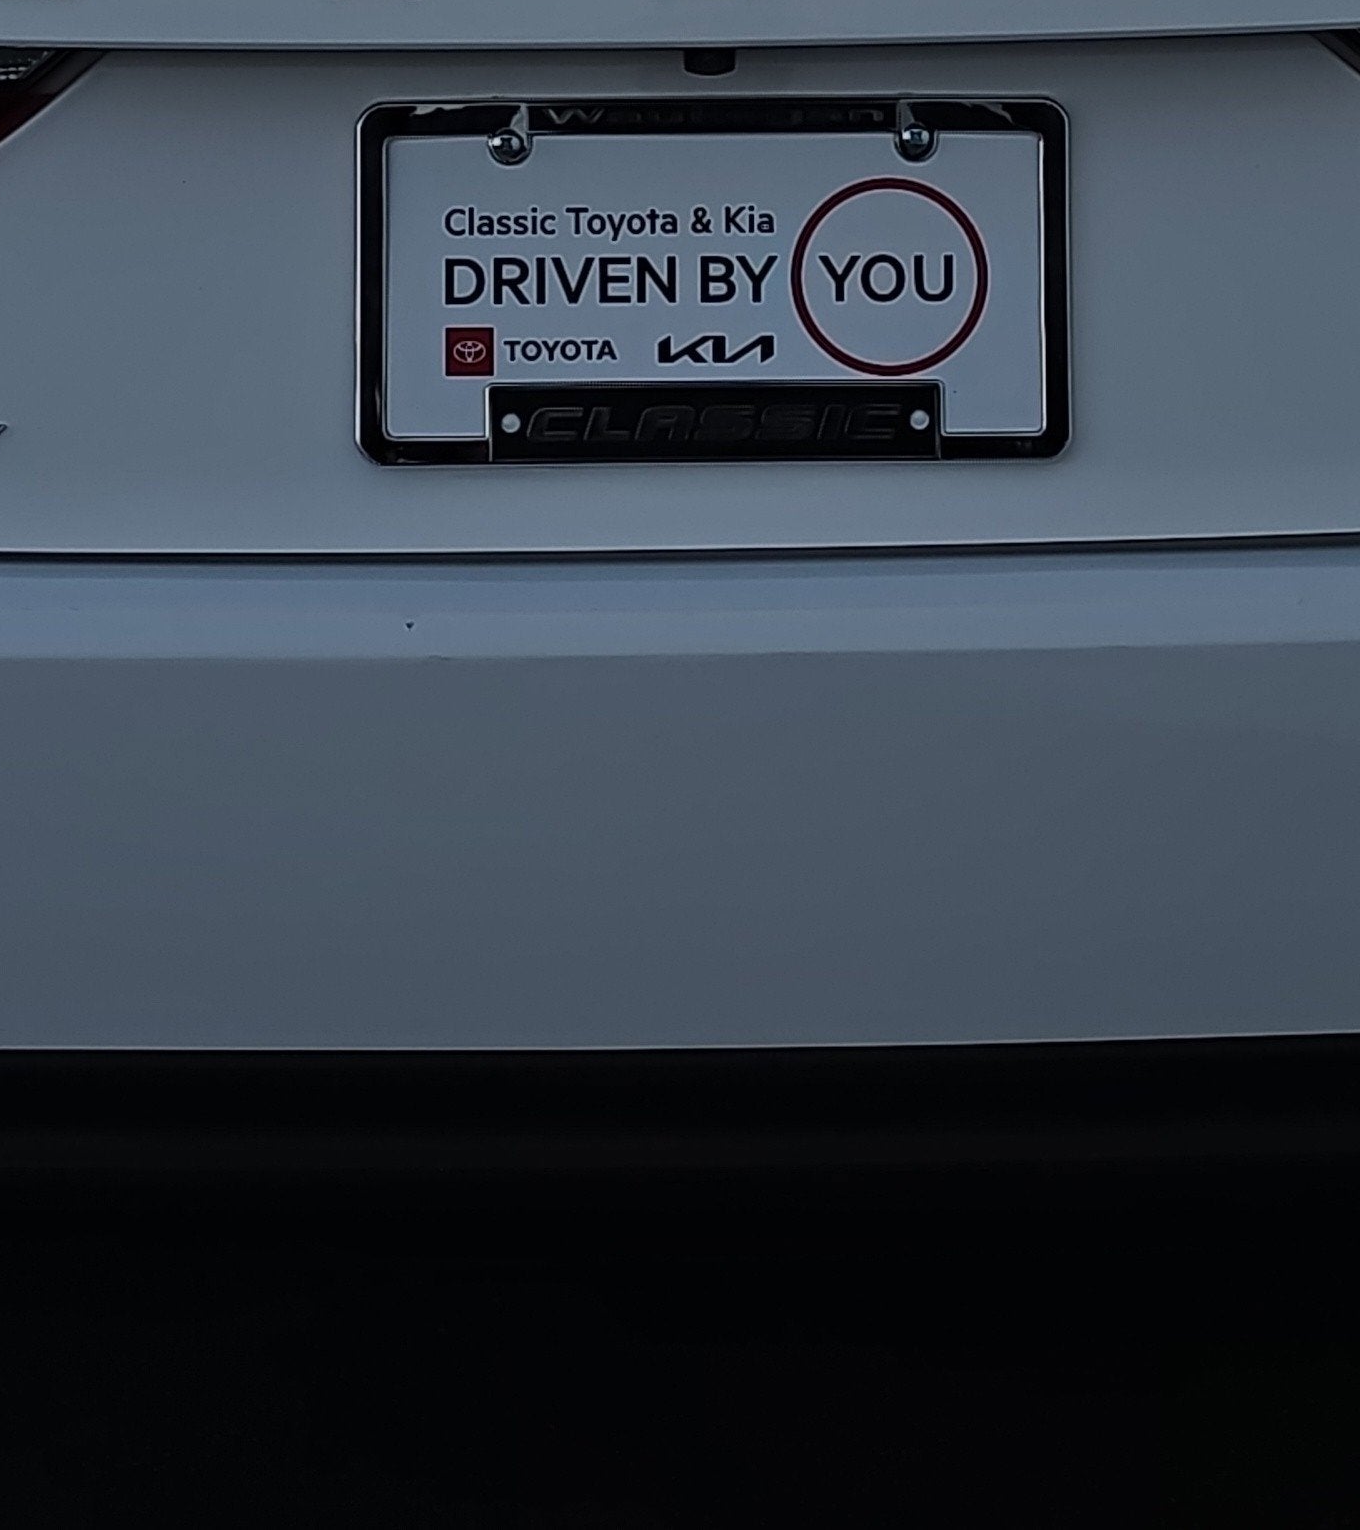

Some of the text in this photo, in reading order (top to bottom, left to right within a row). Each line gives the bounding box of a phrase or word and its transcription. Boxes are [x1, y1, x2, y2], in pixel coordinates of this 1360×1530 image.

[444, 205, 776, 243] Classic Toyota & Kia
[444, 253, 956, 306] DRIVEN BY YOU
[503, 339, 619, 363] TOYOTA
[525, 402, 904, 442] CLASSIC
